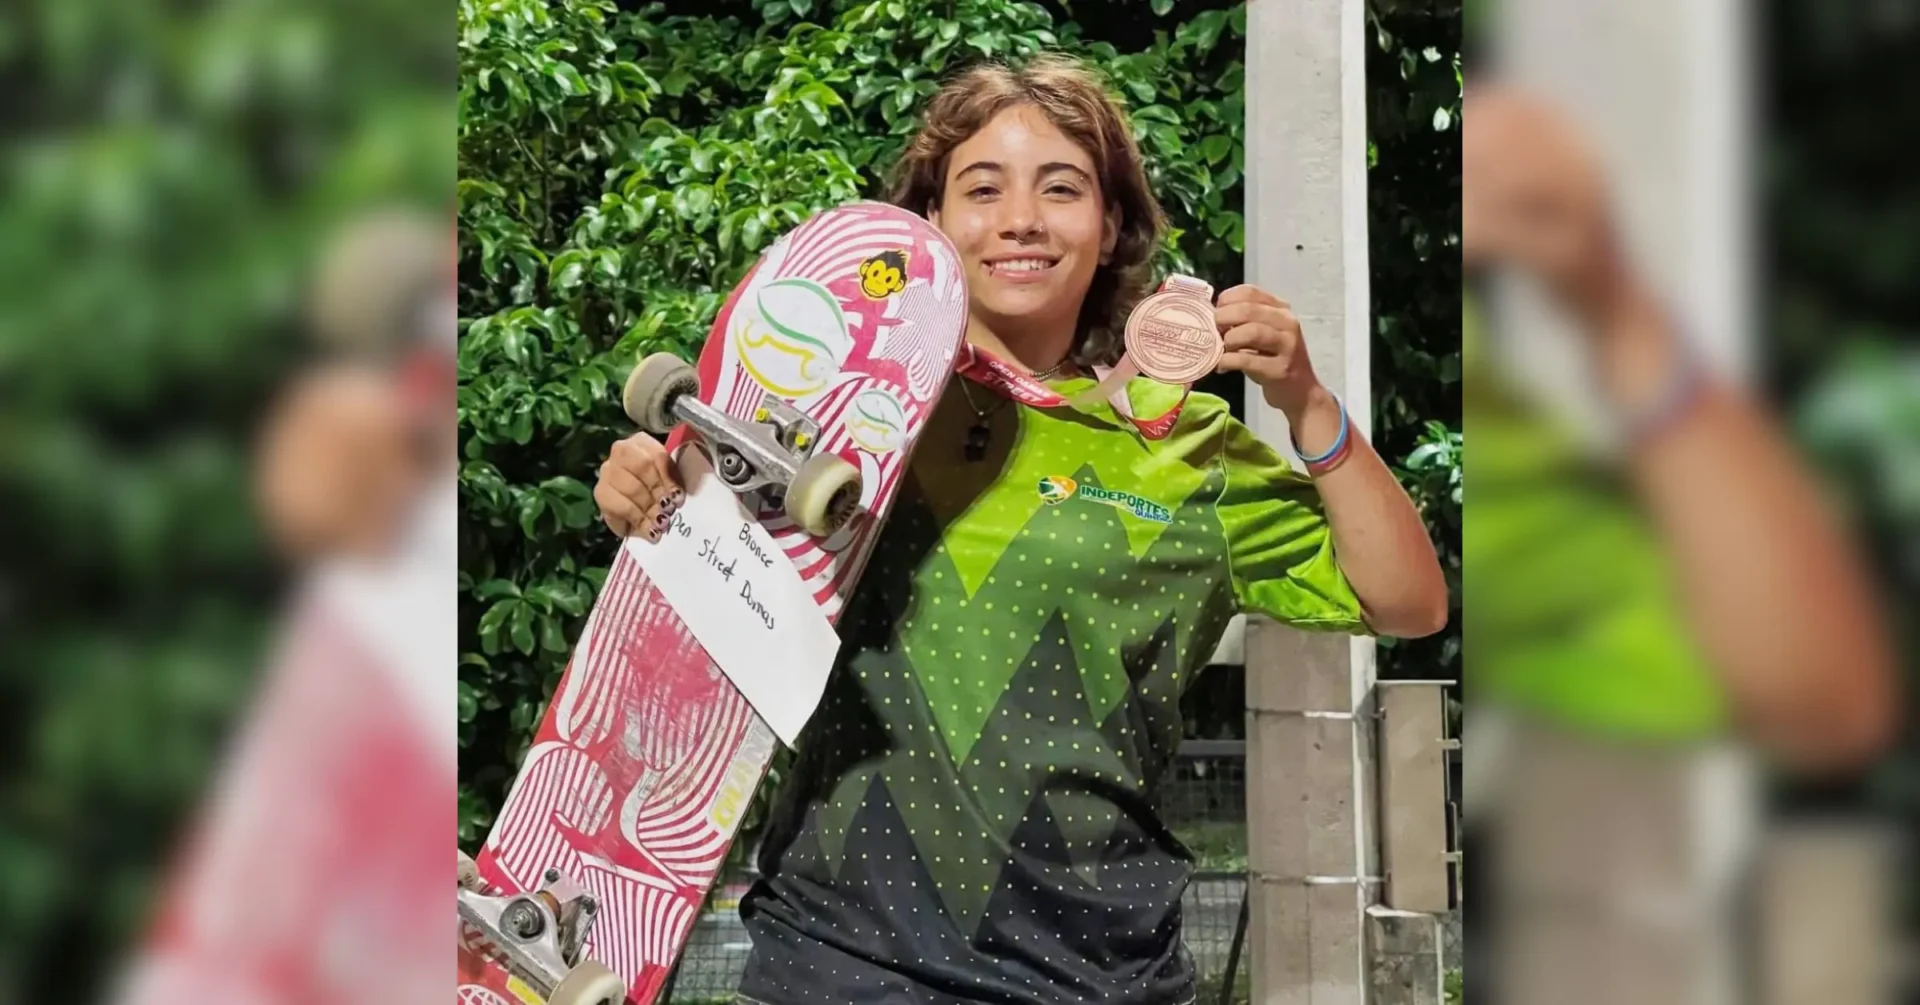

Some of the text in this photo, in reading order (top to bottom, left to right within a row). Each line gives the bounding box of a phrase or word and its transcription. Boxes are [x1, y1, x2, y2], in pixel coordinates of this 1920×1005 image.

[989, 361, 1016, 378] OPEN
[983, 371, 1044, 402] STREET
[1080, 486, 1170, 519] INDEPORTES
[666, 511, 692, 538] pen
[698, 536, 737, 582] Street
[739, 522, 774, 568] Bronce
